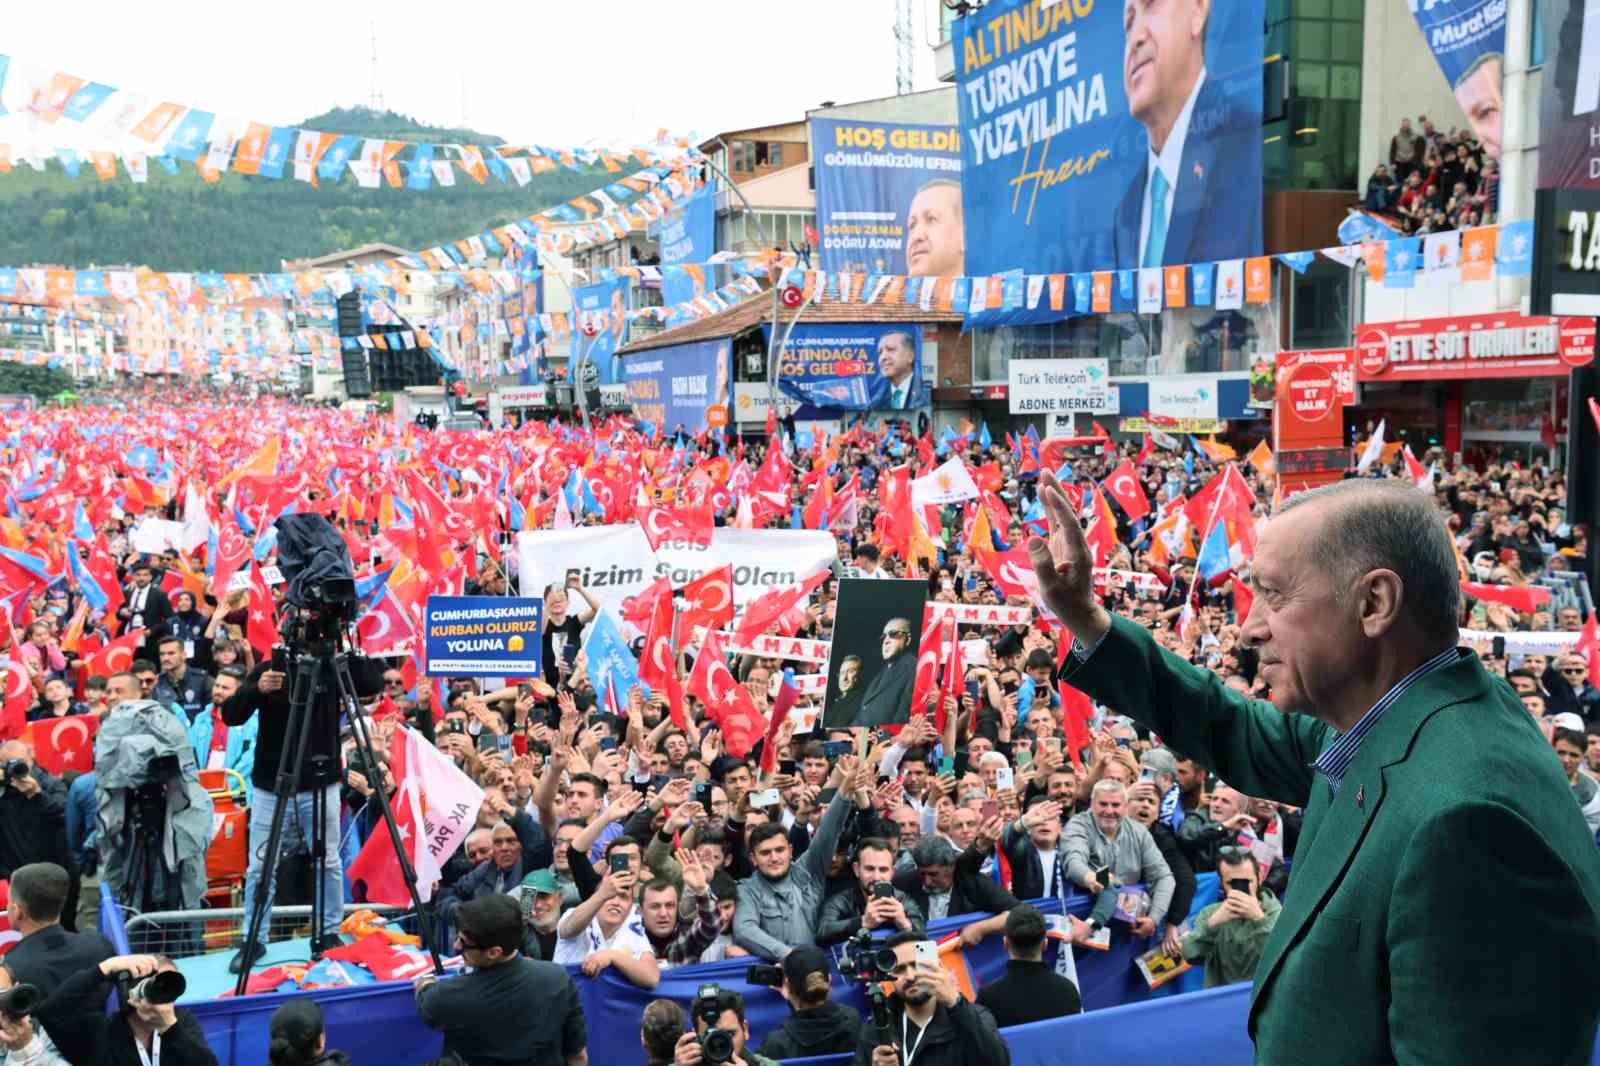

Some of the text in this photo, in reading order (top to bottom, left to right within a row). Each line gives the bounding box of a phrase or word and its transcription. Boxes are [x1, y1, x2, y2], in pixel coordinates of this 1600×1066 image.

[966, 31, 1078, 120] TÜRKİYE
[969, 73, 1108, 165] YÜZYILINA
[835, 127, 886, 151] HOŞ
[824, 151, 924, 169] GÖNLÜMÜZÜN
[823, 236, 866, 250] DOĞRU
[1043, 372, 1087, 385] Telekom
[1303, 388, 1319, 400] ET
[1019, 399, 1056, 410] ABONE
[1295, 399, 1328, 411] BALIK
[732, 565, 796, 587] Olan
[430, 606, 538, 621] CUMHURBAŞKANIM
[934, 607, 1019, 621] AMAK
[430, 620, 537, 637] KURBAN OLURUZ
[446, 637, 504, 653] YOLUNA
